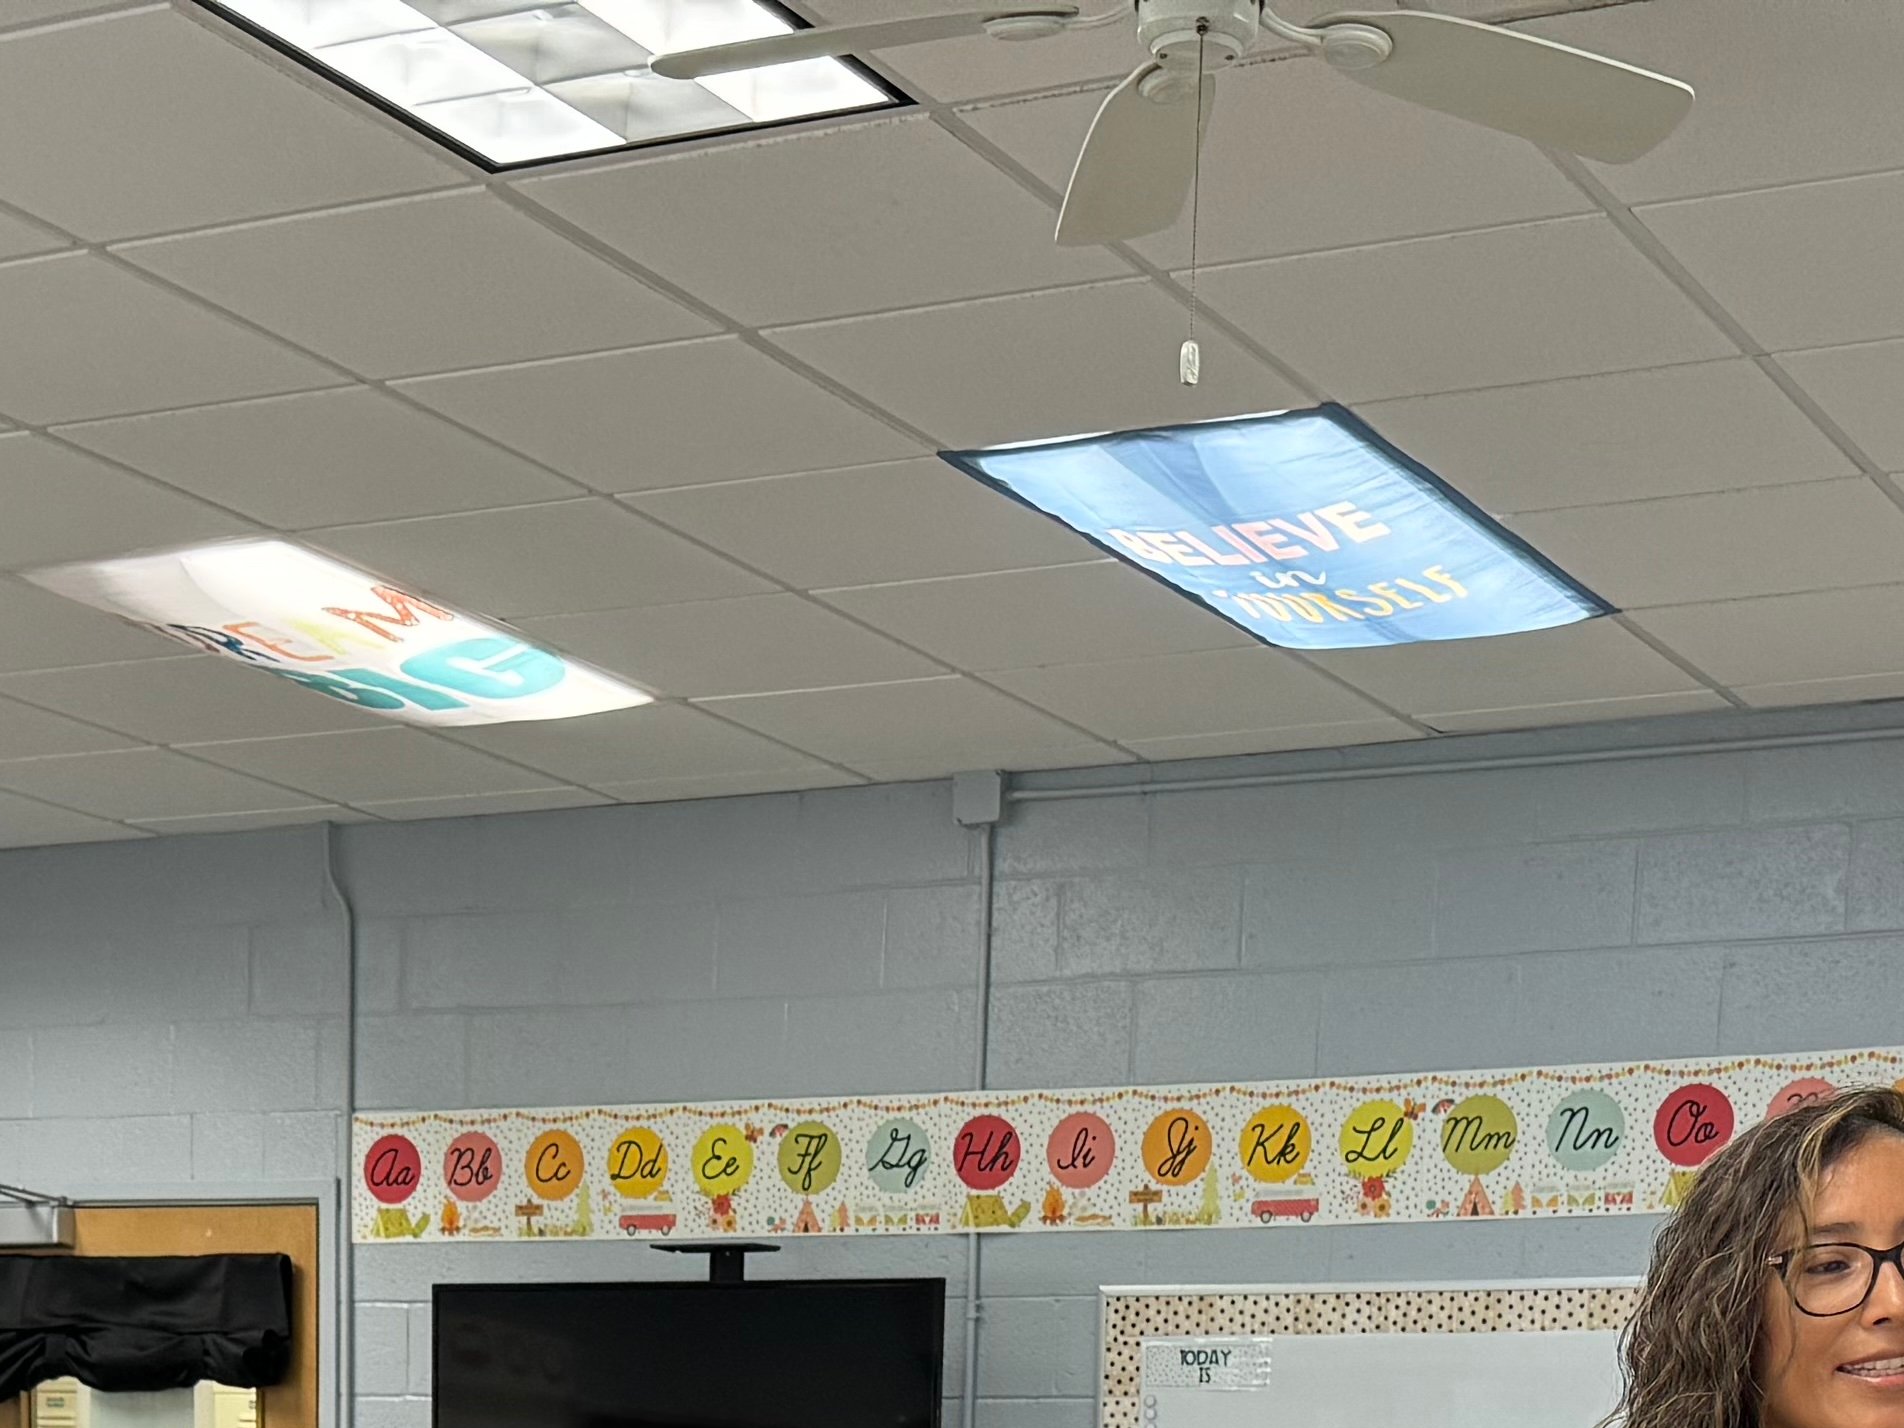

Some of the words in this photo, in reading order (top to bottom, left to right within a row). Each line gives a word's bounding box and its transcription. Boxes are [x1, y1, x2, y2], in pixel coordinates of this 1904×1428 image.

[1106, 499, 1391, 566] BELIEVE
[1249, 568, 1327, 588] in
[1246, 1121, 1301, 1165] Kk
[1344, 1115, 1401, 1163] Ll
[1442, 1114, 1517, 1154] Mm
[1554, 1106, 1620, 1153] Nn
[1666, 1098, 1720, 1147] Oo
[370, 1149, 415, 1189] Aa
[446, 1147, 494, 1186] Bb
[534, 1143, 569, 1184] Cc
[610, 1139, 662, 1180] Dd
[701, 1138, 741, 1179] Ee
[787, 1131, 829, 1188] Ff
[961, 1131, 1015, 1172] Hh
[1180, 1349, 1232, 1367] TODAY
[1199, 1367, 1211, 1383] IS
